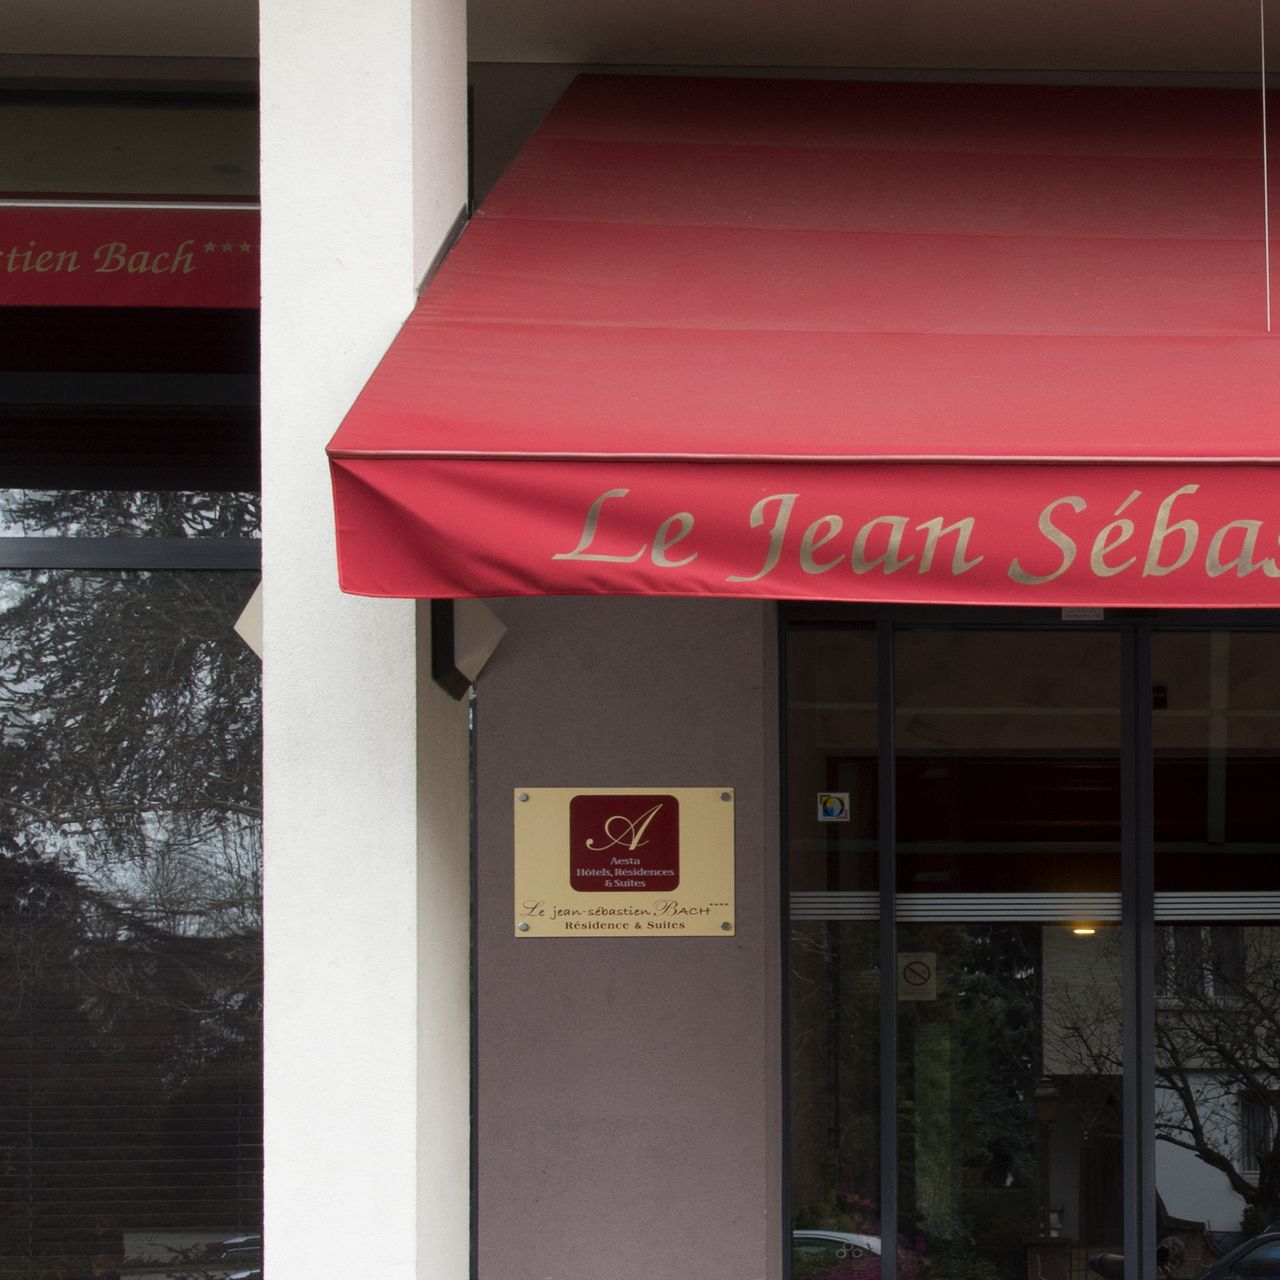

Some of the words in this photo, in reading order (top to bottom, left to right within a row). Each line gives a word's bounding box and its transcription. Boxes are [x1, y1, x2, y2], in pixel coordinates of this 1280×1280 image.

[0, 240, 80, 272] tien
[93, 239, 195, 274] Bach
[551, 488, 700, 568] Le
[725, 493, 985, 583] Jean
[610, 857, 641, 865] Aesta
[614, 867, 675, 876] Résidences
[614, 879, 646, 887] Suites
[520, 900, 546, 917] Le
[565, 920, 630, 930] Résidence
[634, 921, 642, 930] &
[647, 920, 686, 930] Suites
